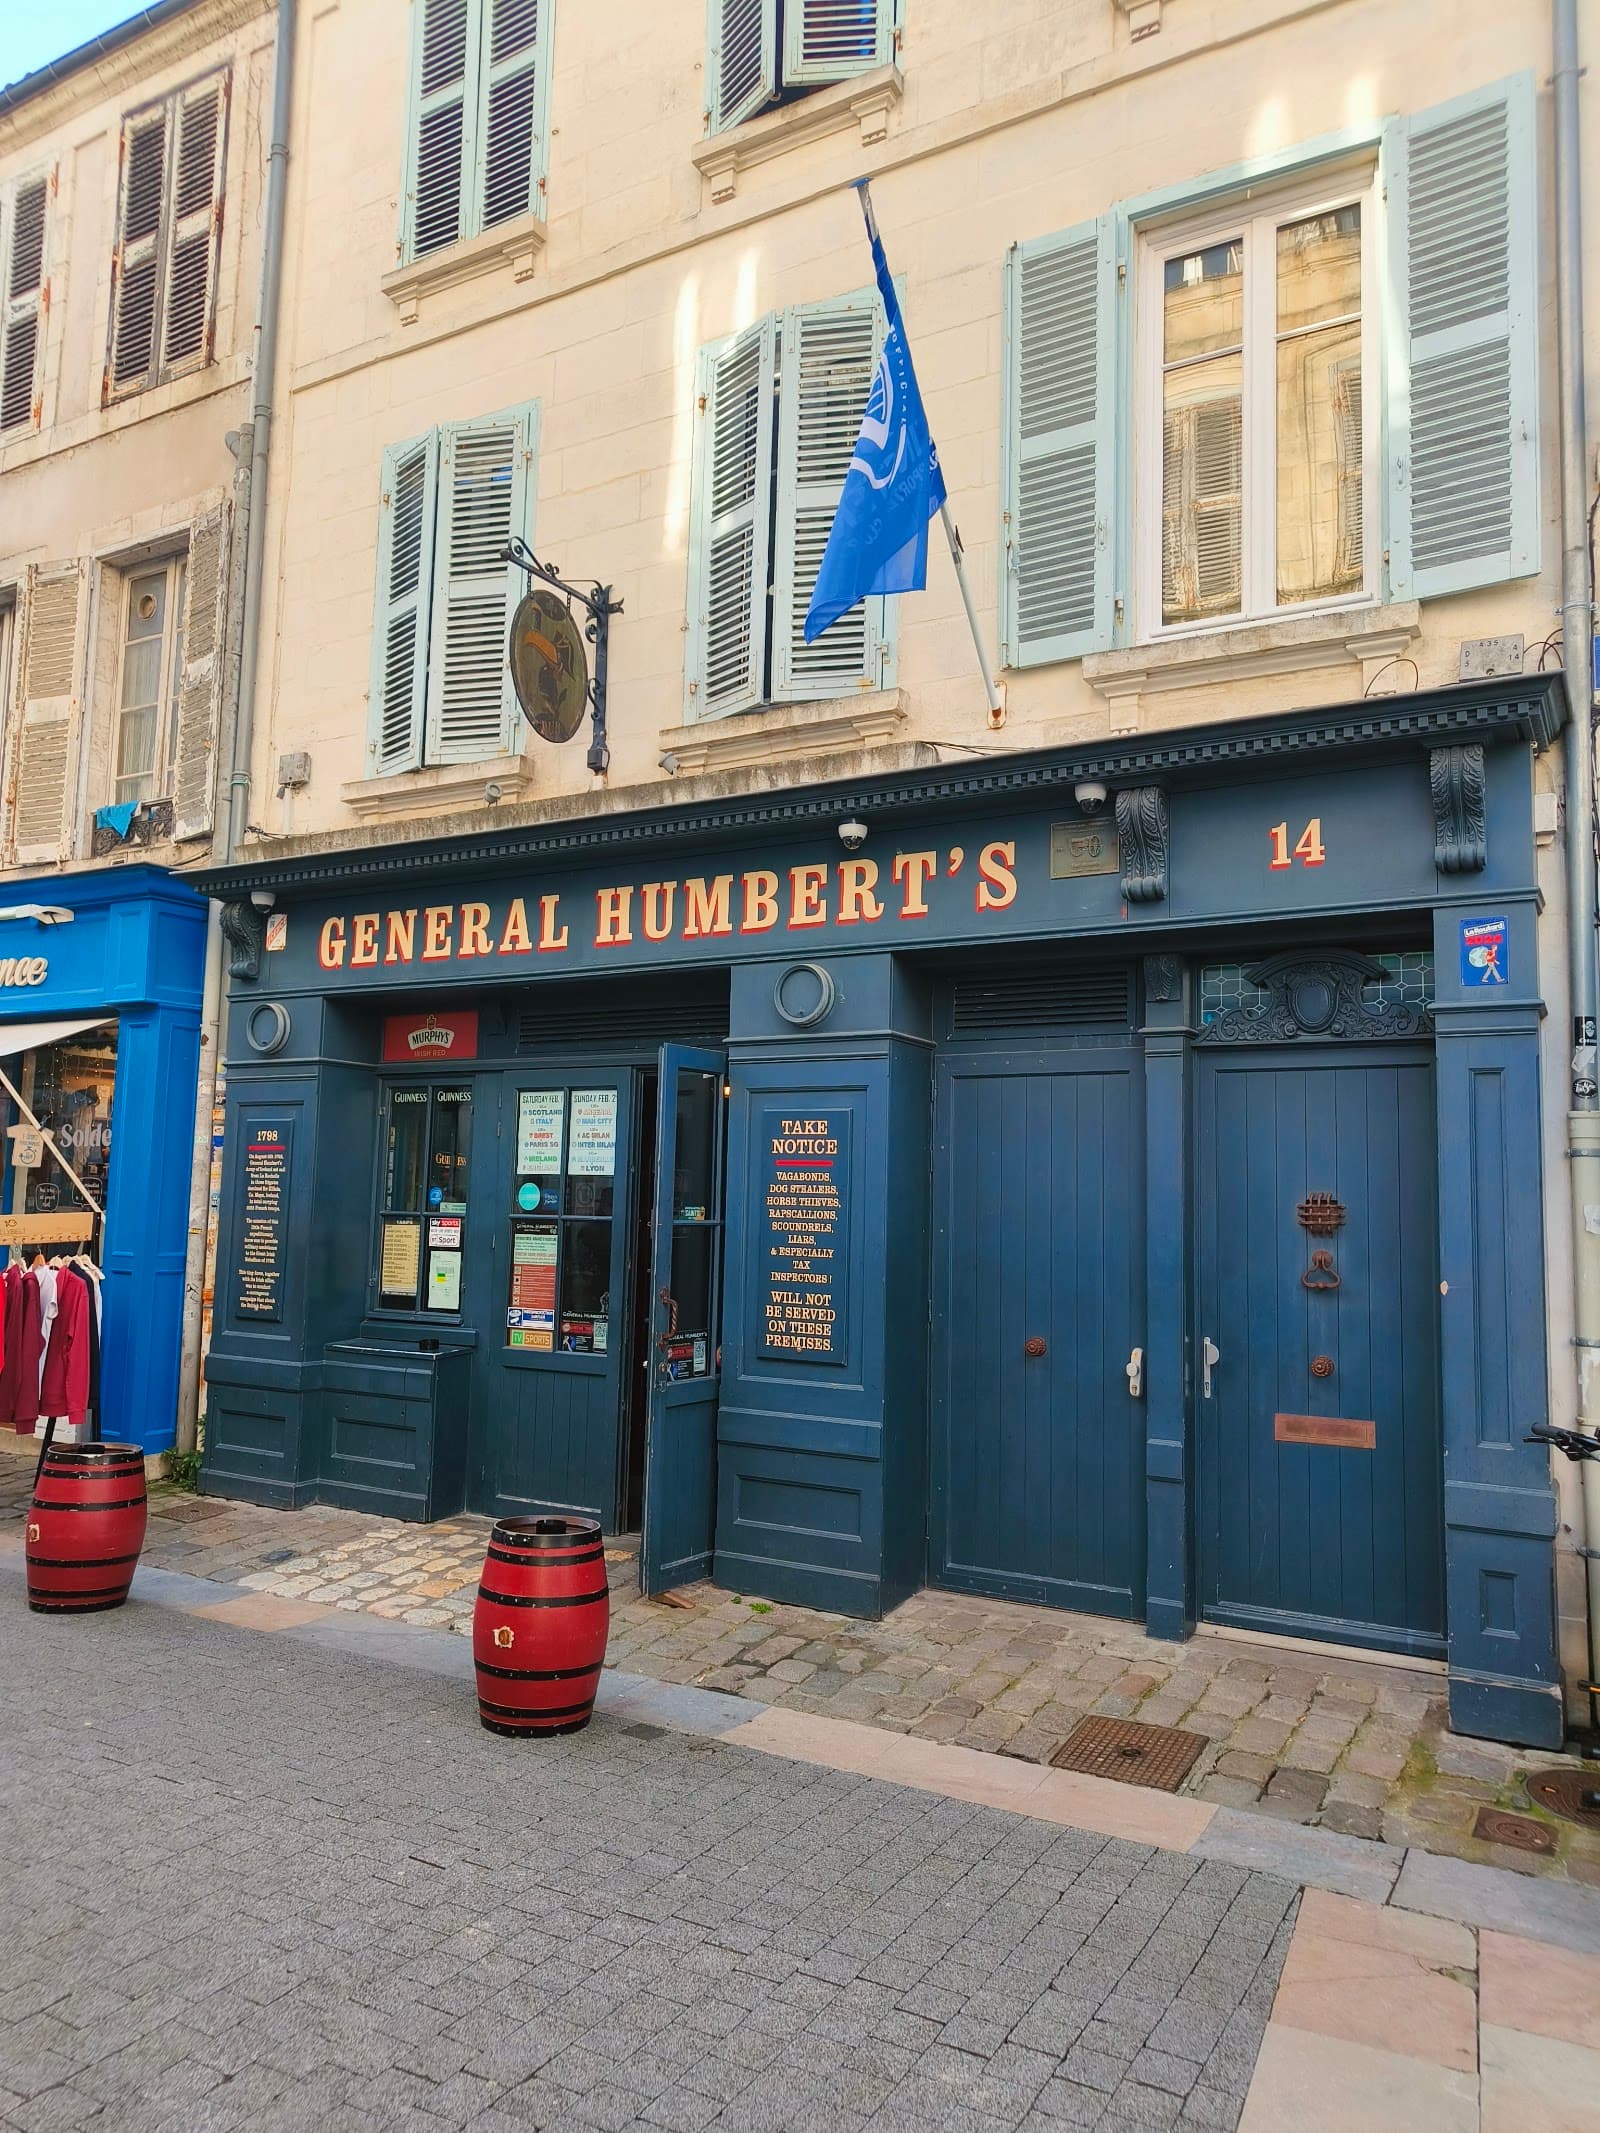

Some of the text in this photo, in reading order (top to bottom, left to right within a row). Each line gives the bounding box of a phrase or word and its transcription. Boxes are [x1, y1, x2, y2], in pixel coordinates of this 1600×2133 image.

[1267, 818, 1326, 872] 14
[319, 841, 1019, 970] GENERAL HUMBERT'S
[394, 1092, 428, 1103] GUINNESS
[437, 1090, 472, 1102] GUINNESS
[522, 1095, 548, 1104] SATURDAY
[573, 1094, 597, 1103] SUNDAY
[781, 1120, 828, 1135] TAKE
[256, 1130, 278, 1142] 1798
[771, 1139, 838, 1154] NOTICE
[776, 1171, 832, 1183] VAGABONDS,
[769, 1184, 839, 1195] DOG STEALERS,
[766, 1196, 841, 1208] HORSE THIEVES,
[768, 1209, 838, 1221] RAPSCALLIONS,
[771, 1221, 834, 1233] SCOUNDRELS,
[438, 1236, 456, 1244] Sport
[788, 1234, 817, 1246] LIARS,
[770, 1246, 835, 1258] & ESPECIALLY
[792, 1260, 811, 1270] TAX
[770, 1290, 832, 1307] WILL NOT
[562, 1310, 583, 1319] GENERAL
[766, 1304, 836, 1321] BE SERVED
[768, 1319, 832, 1336] ON THESE
[513, 1332, 550, 1345] TV SPORTS
[765, 1334, 834, 1352] PREMISES.
